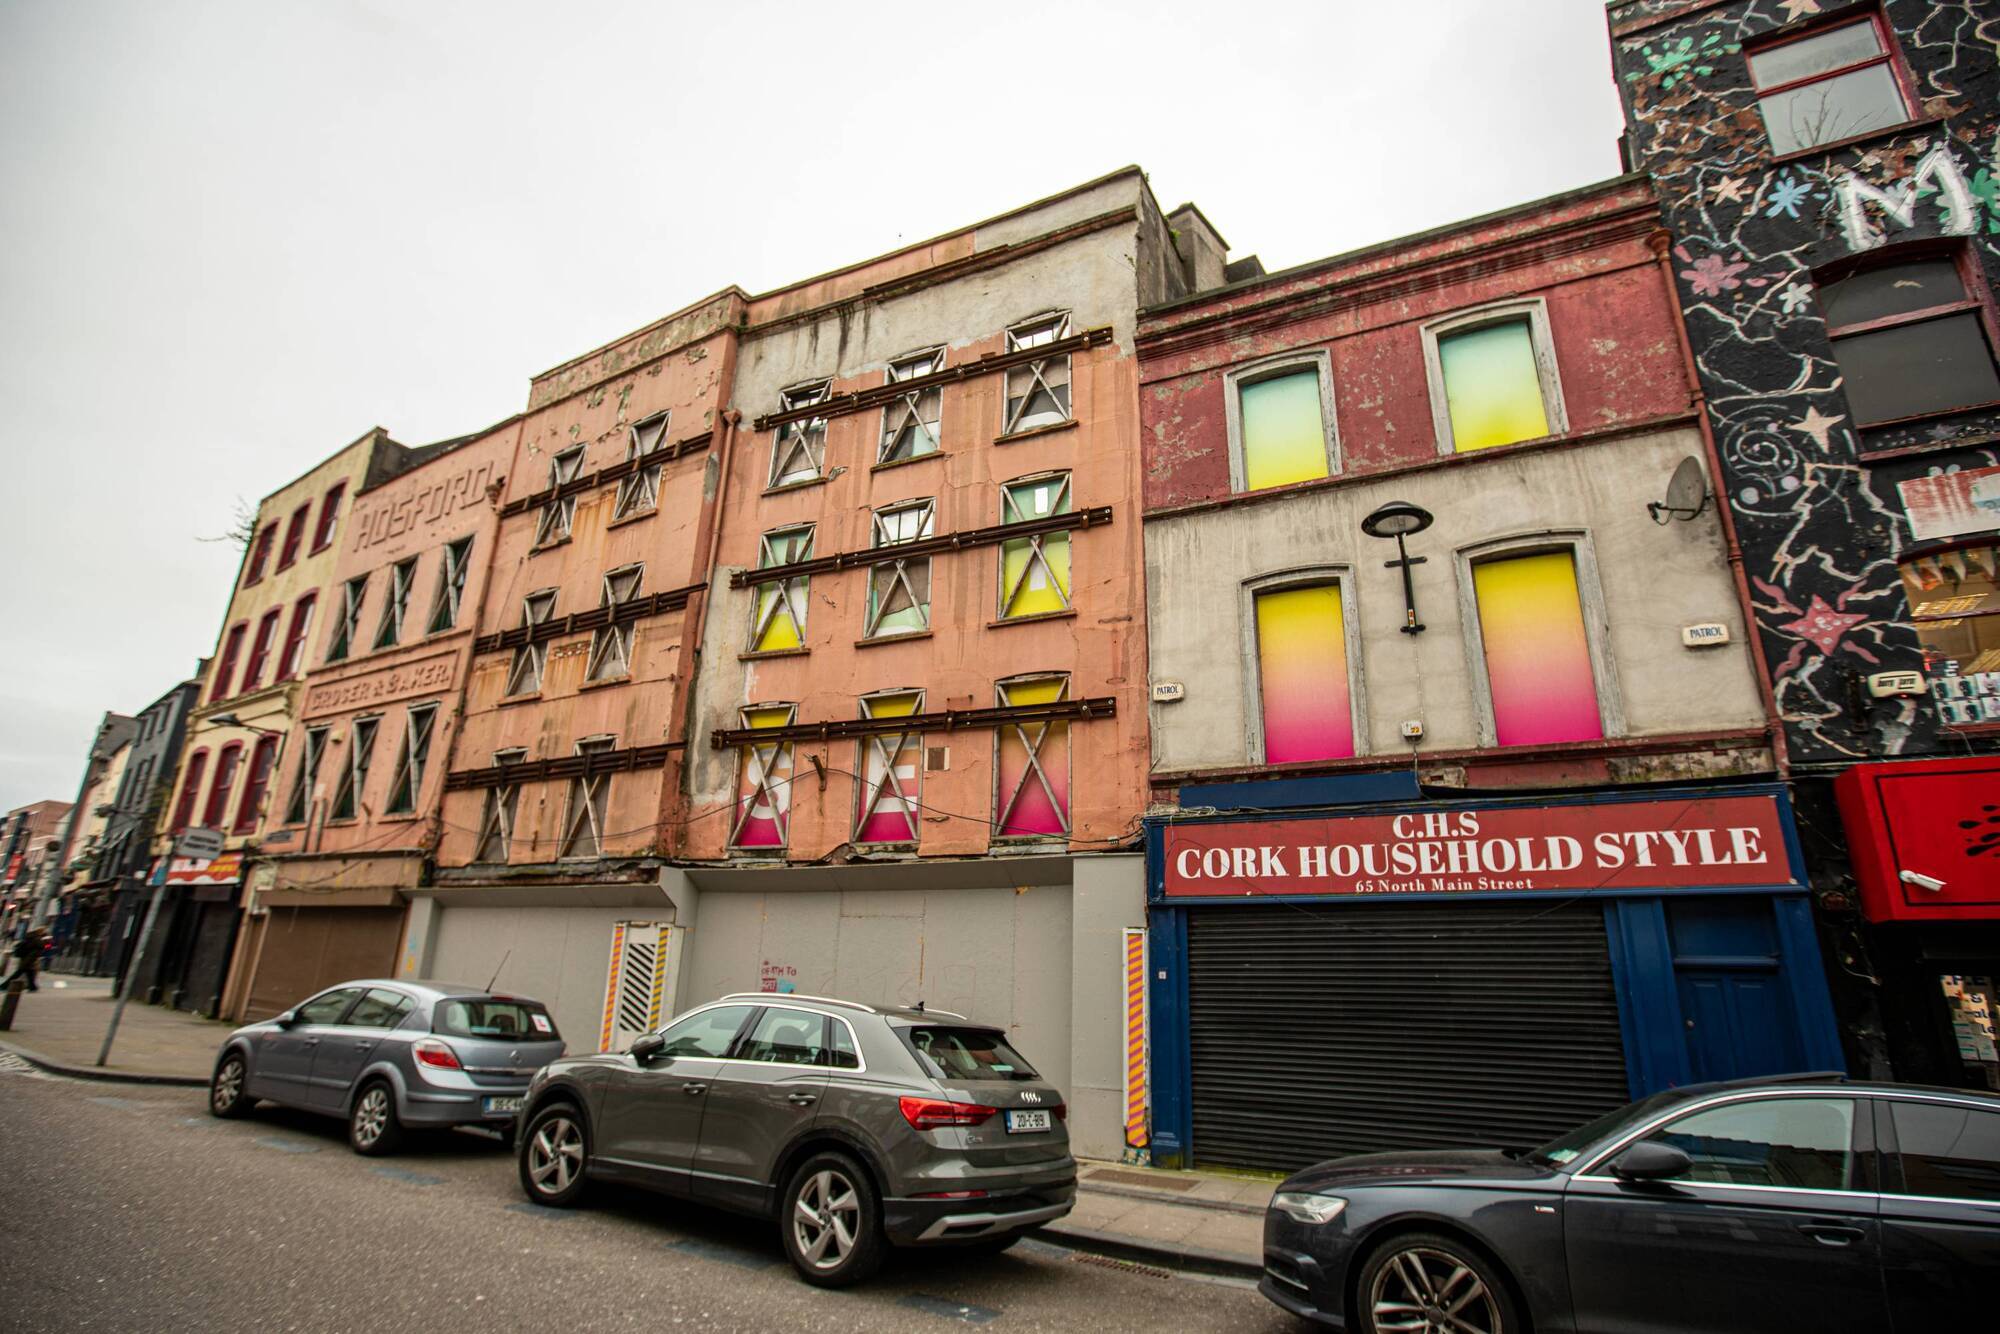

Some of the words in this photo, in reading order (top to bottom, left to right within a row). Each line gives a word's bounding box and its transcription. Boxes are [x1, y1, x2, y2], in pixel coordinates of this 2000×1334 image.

[353, 461, 494, 553] HOSFORD
[1690, 626, 1722, 639] PATROL
[1156, 685, 1179, 696] PATROL
[1392, 810, 1480, 839] C.H.S
[1176, 846, 1290, 879] CORK
[1297, 835, 1584, 878] HOUSEHOLD
[1593, 826, 1768, 869] STYLE
[1355, 880, 1374, 893] 65
[1378, 878, 1426, 892] North
[1431, 877, 1474, 891] Main
[1478, 876, 1534, 890] Street
